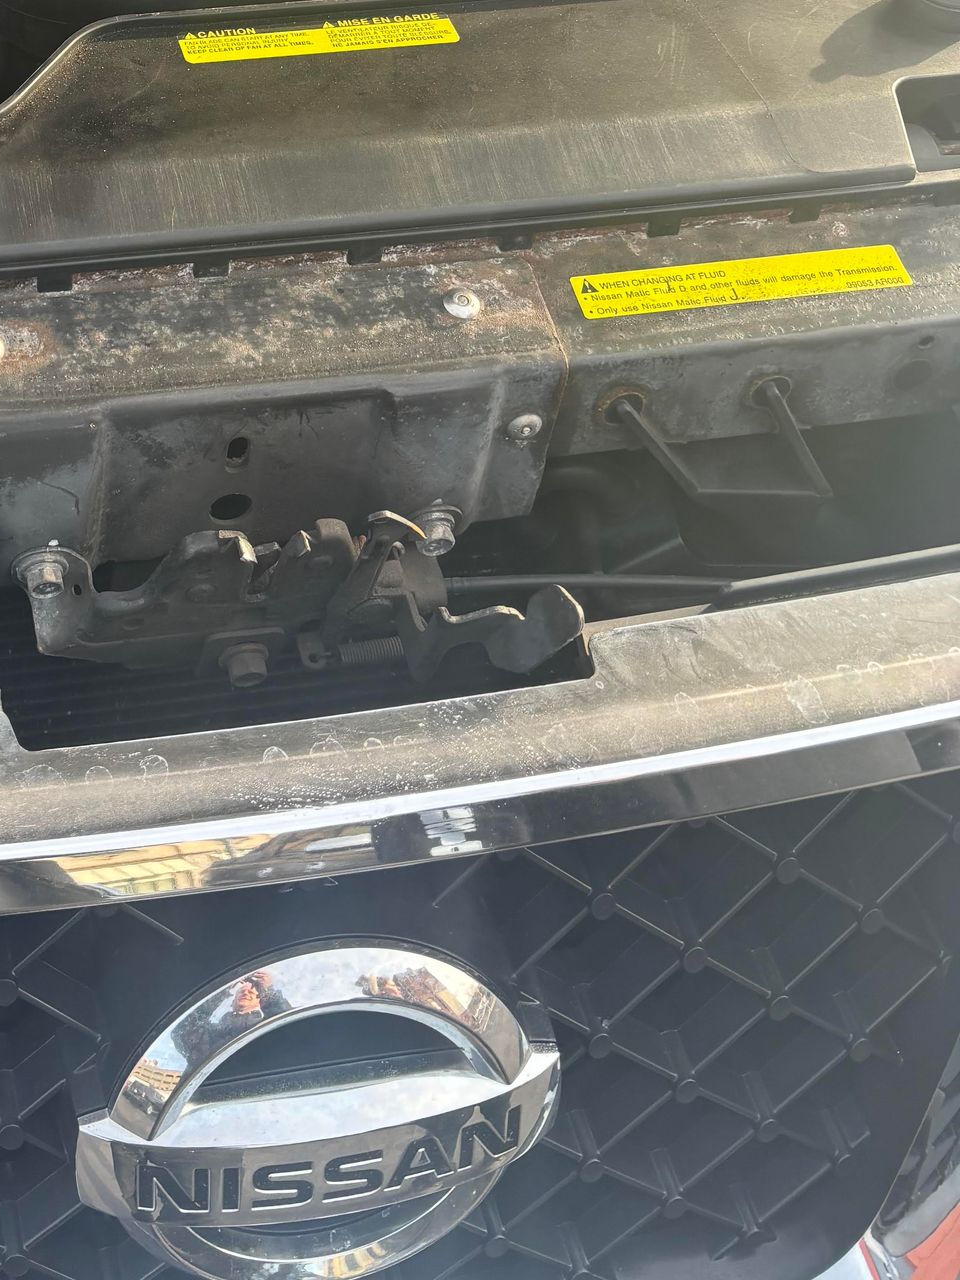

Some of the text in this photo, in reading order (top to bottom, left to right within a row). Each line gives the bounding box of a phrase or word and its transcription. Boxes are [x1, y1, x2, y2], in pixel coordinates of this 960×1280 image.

[337, 12, 440, 27] MISE EN GARDE
[197, 27, 256, 39] CAUTION
[590, 292, 623, 302] Nissan
[625, 289, 651, 299] Matic
[653, 286, 676, 295] Fluid
[690, 283, 707, 292] and
[709, 281, 733, 290] other
[735, 277, 760, 286] fluids
[762, 275, 778, 284] will
[780, 271, 816, 282] damage
[819, 270, 834, 278] the
[835, 264, 898, 277] Transmission.
[599, 270, 726, 290] WHEN CHANGING AT FLUID
[596, 306, 618, 315] Only
[641, 300, 673, 310] Nissan
[675, 297, 701, 307] Matic
[704, 294, 727, 304] Fluid
[136, 1104, 522, 1214] NISSAN
